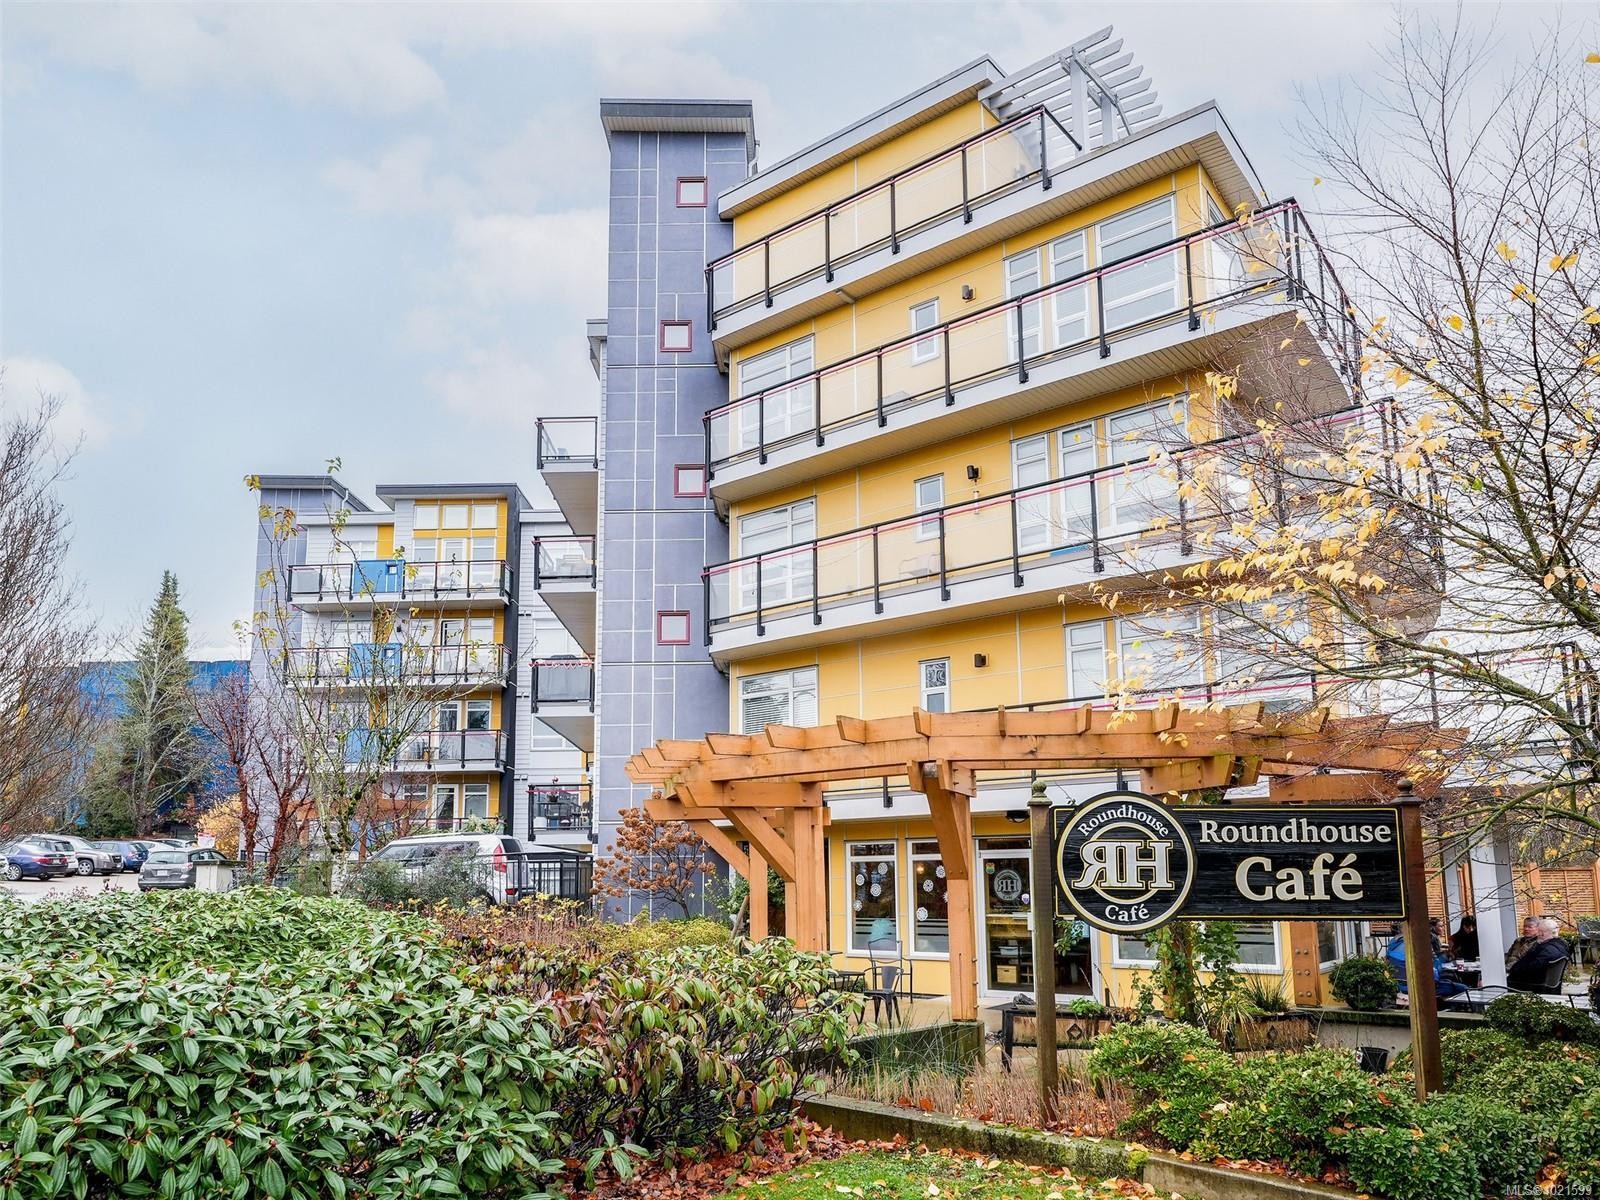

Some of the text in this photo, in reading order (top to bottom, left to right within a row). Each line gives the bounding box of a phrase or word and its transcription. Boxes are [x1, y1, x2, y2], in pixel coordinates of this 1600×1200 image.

[1078, 804, 1169, 837] Roundhouse
[1199, 818, 1392, 843] Roundhouse
[1235, 853, 1364, 901] Café
[1105, 904, 1150, 922] Café
